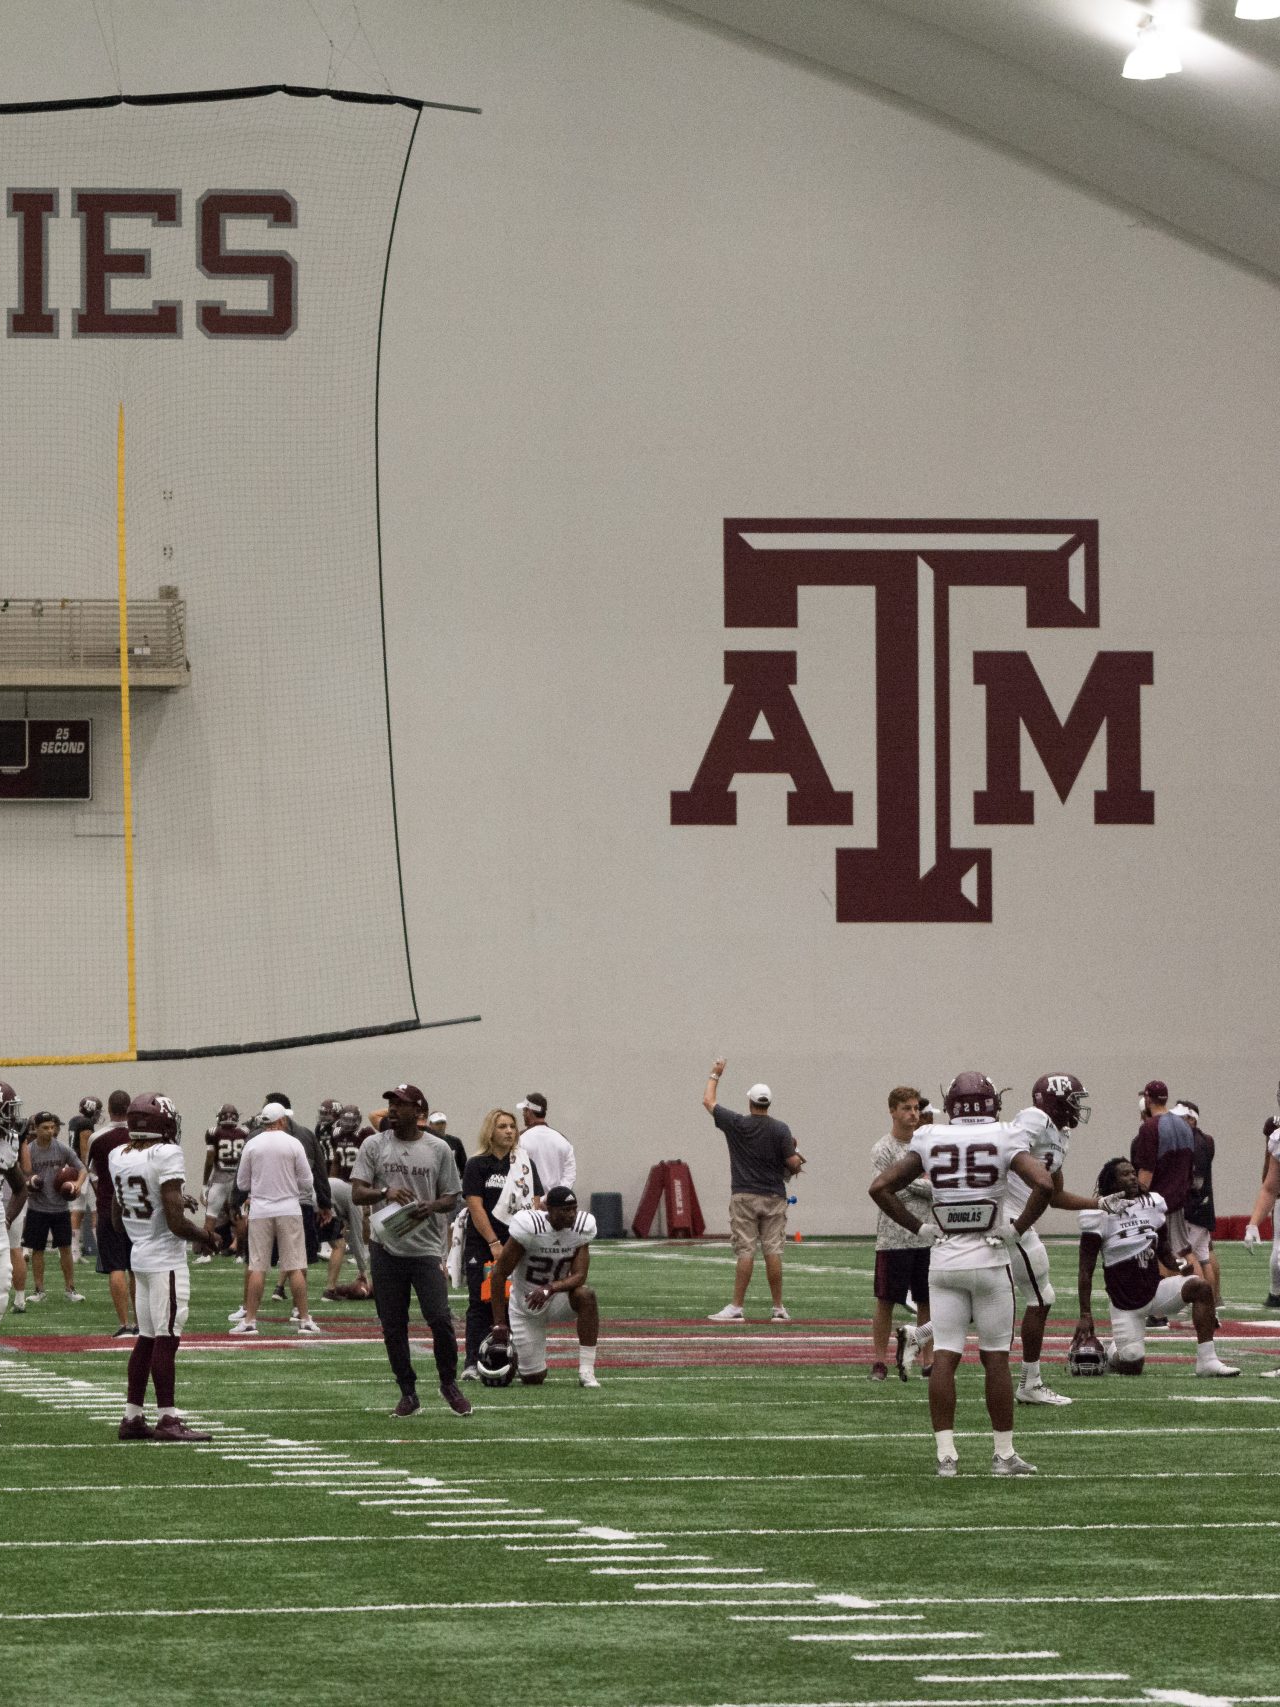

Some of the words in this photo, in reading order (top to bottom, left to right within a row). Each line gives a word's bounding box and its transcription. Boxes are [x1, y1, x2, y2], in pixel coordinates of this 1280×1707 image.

[55, 727, 70, 740] 25
[40, 741, 85, 754] SECOND
[383, 1163, 409, 1175] TEXAS
[411, 1167, 431, 1178] A&M
[929, 1143, 999, 1189] 26
[114, 1174, 155, 1220] 13
[947, 1211, 982, 1223] DOUGLAS
[1120, 1219, 1139, 1229] TEXAS
